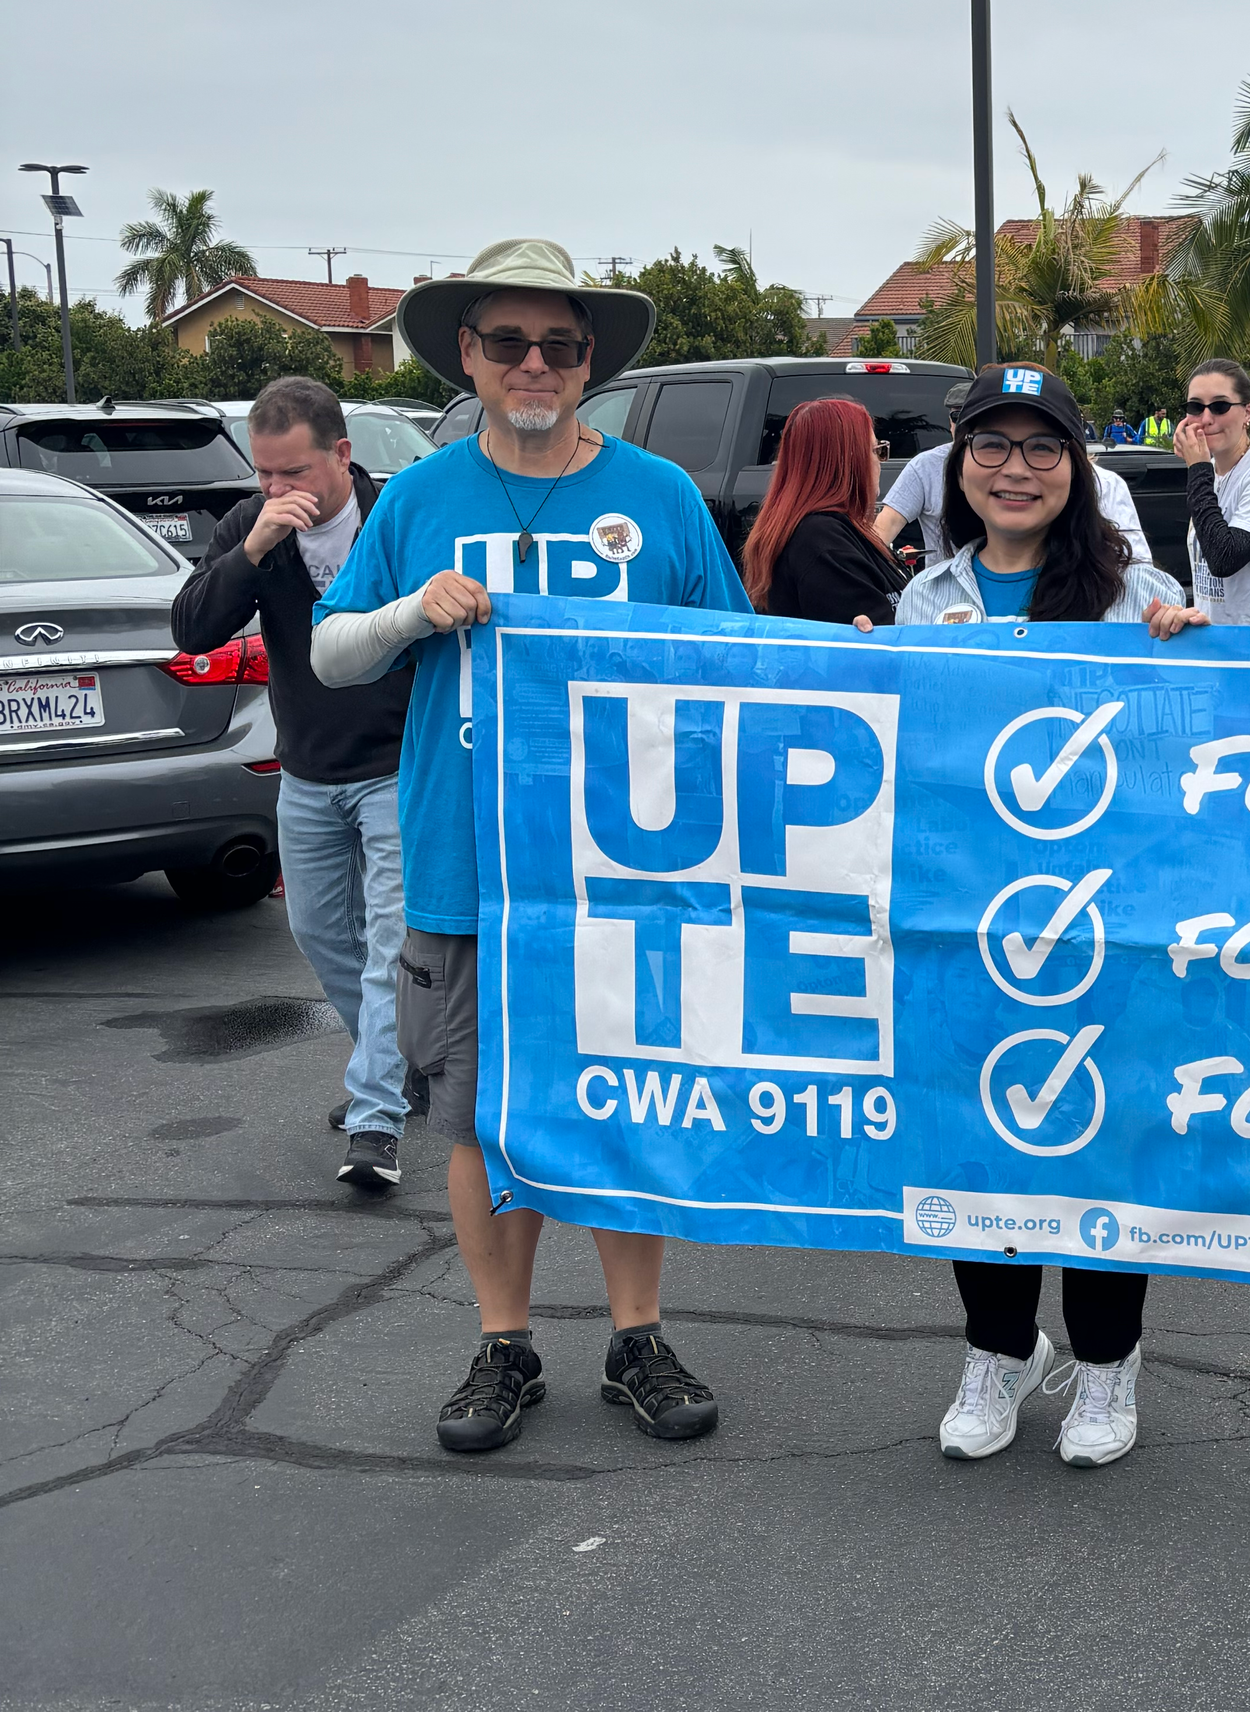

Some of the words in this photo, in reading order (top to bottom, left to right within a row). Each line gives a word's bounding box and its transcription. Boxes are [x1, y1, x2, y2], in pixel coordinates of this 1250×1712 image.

[1006, 368, 1042, 382] UP
[1005, 381, 1040, 395] TE
[3, 653, 100, 669] NFINITI
[7, 678, 80, 696] California
[576, 1065, 727, 1131] CWA
[748, 1081, 897, 1140] 9119
[967, 1211, 1061, 1235] upte.org
